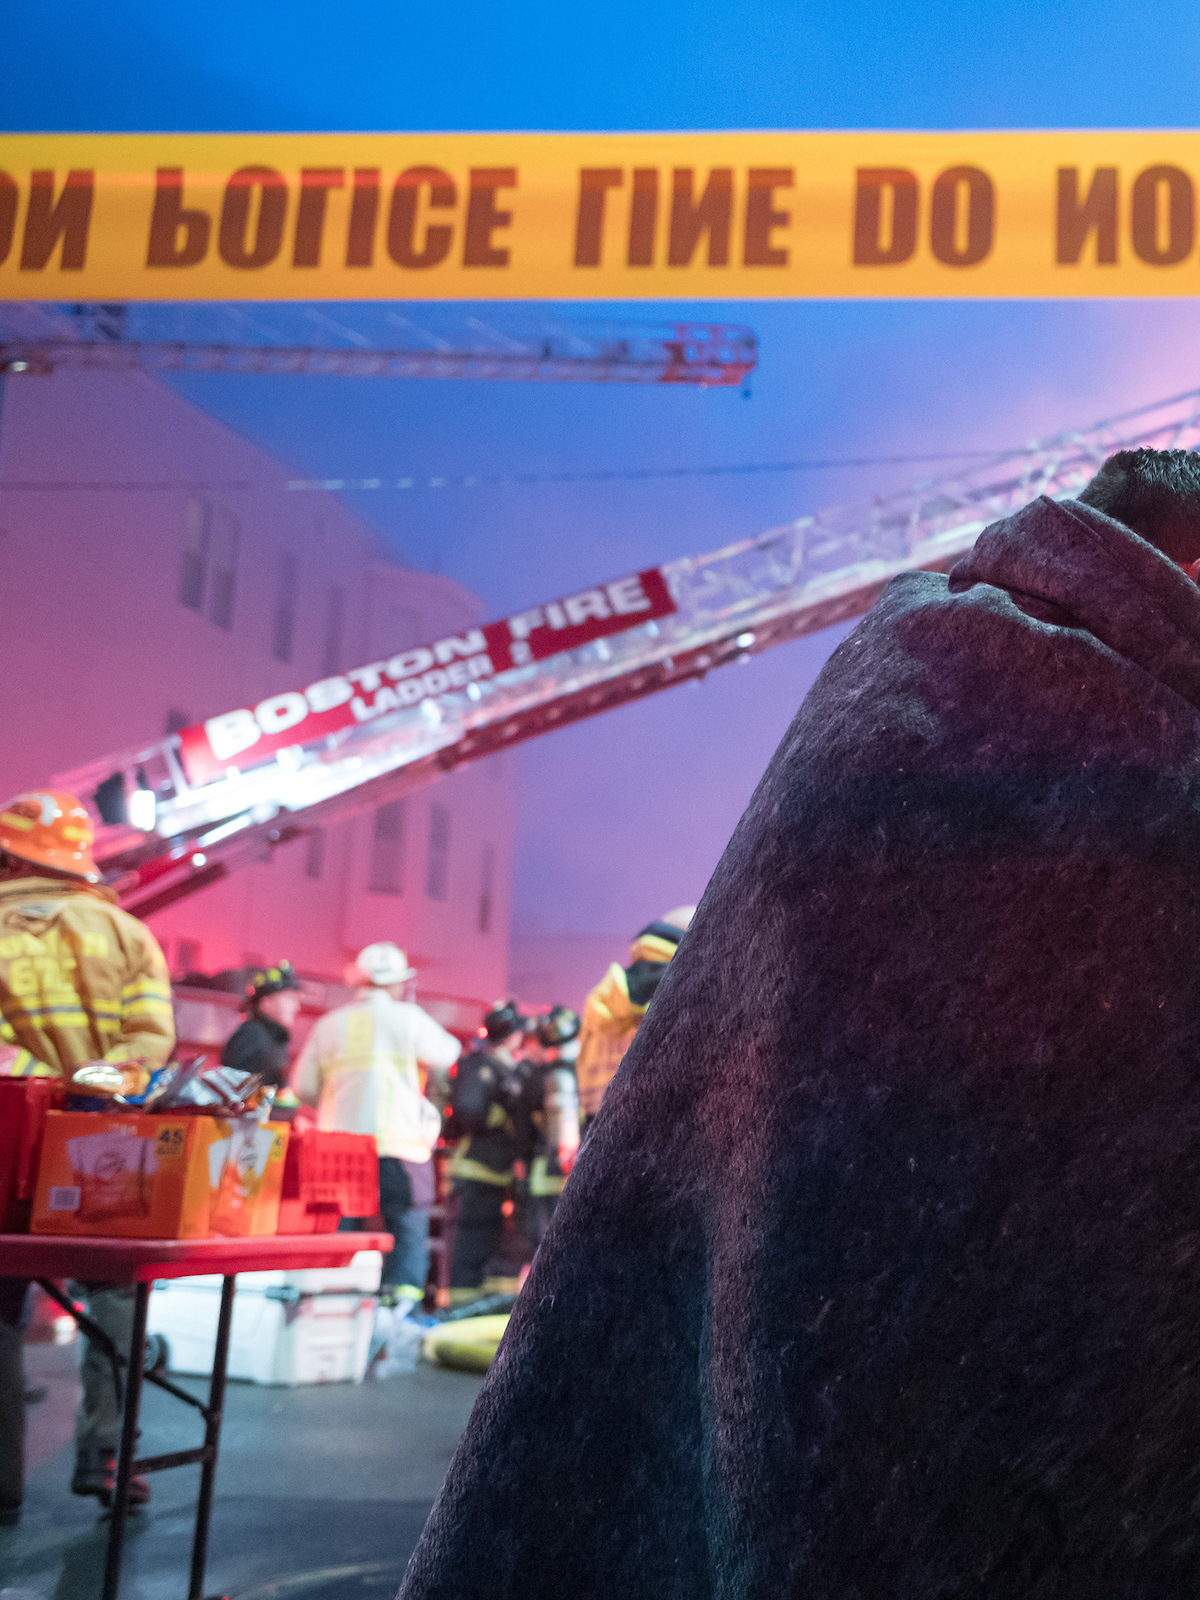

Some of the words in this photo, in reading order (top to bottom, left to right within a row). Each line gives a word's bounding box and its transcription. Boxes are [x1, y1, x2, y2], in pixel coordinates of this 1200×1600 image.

[204, 628, 487, 760] BOSTON
[508, 573, 653, 638] FIRE
[349, 654, 494, 721] LADDER
